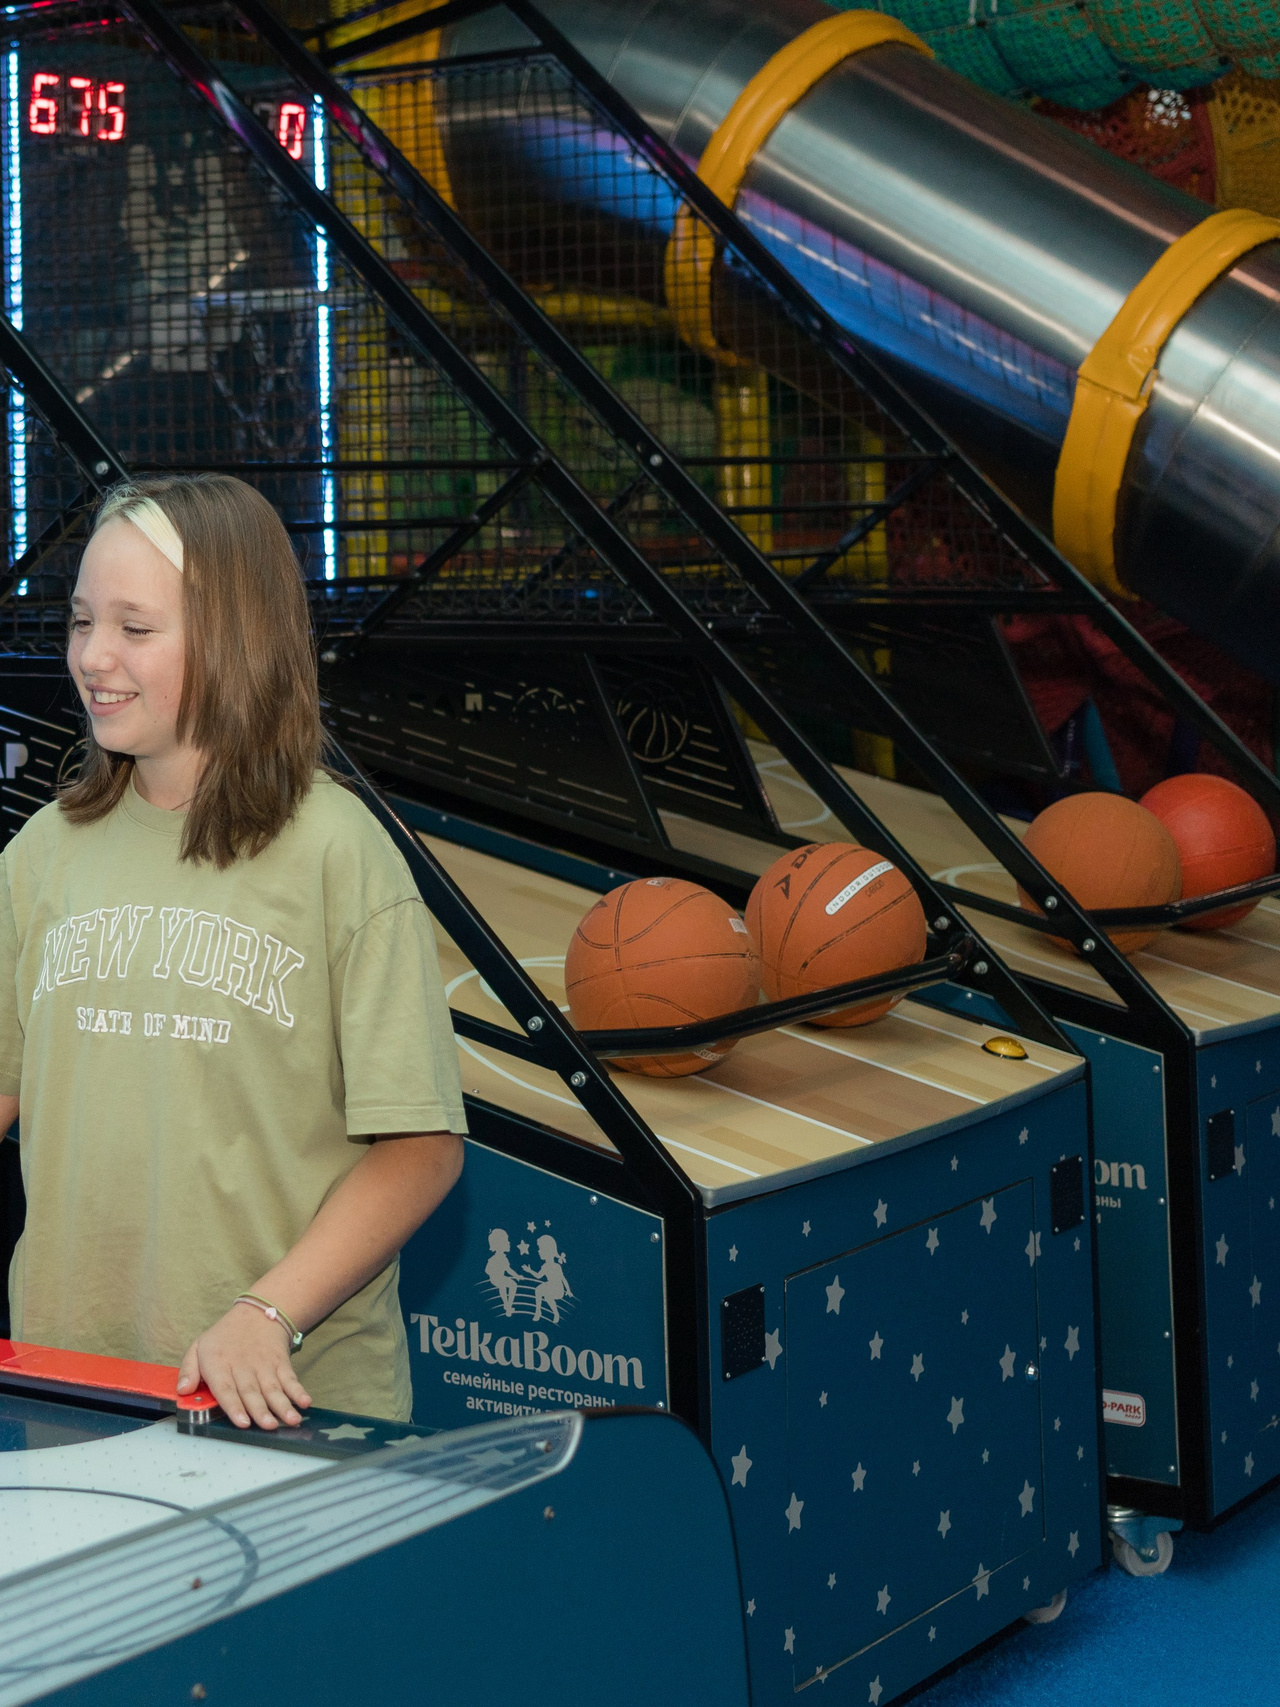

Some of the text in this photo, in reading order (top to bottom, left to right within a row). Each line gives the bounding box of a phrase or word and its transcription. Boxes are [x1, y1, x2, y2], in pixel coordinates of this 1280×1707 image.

[30, 73, 125, 140] 675
[32, 904, 305, 1028] NEW YORK
[76, 1006, 231, 1044] STATE OF MIND
[410, 1313, 646, 1389] TeikaBoom
[443, 1370, 616, 1409] семейные рестораны
